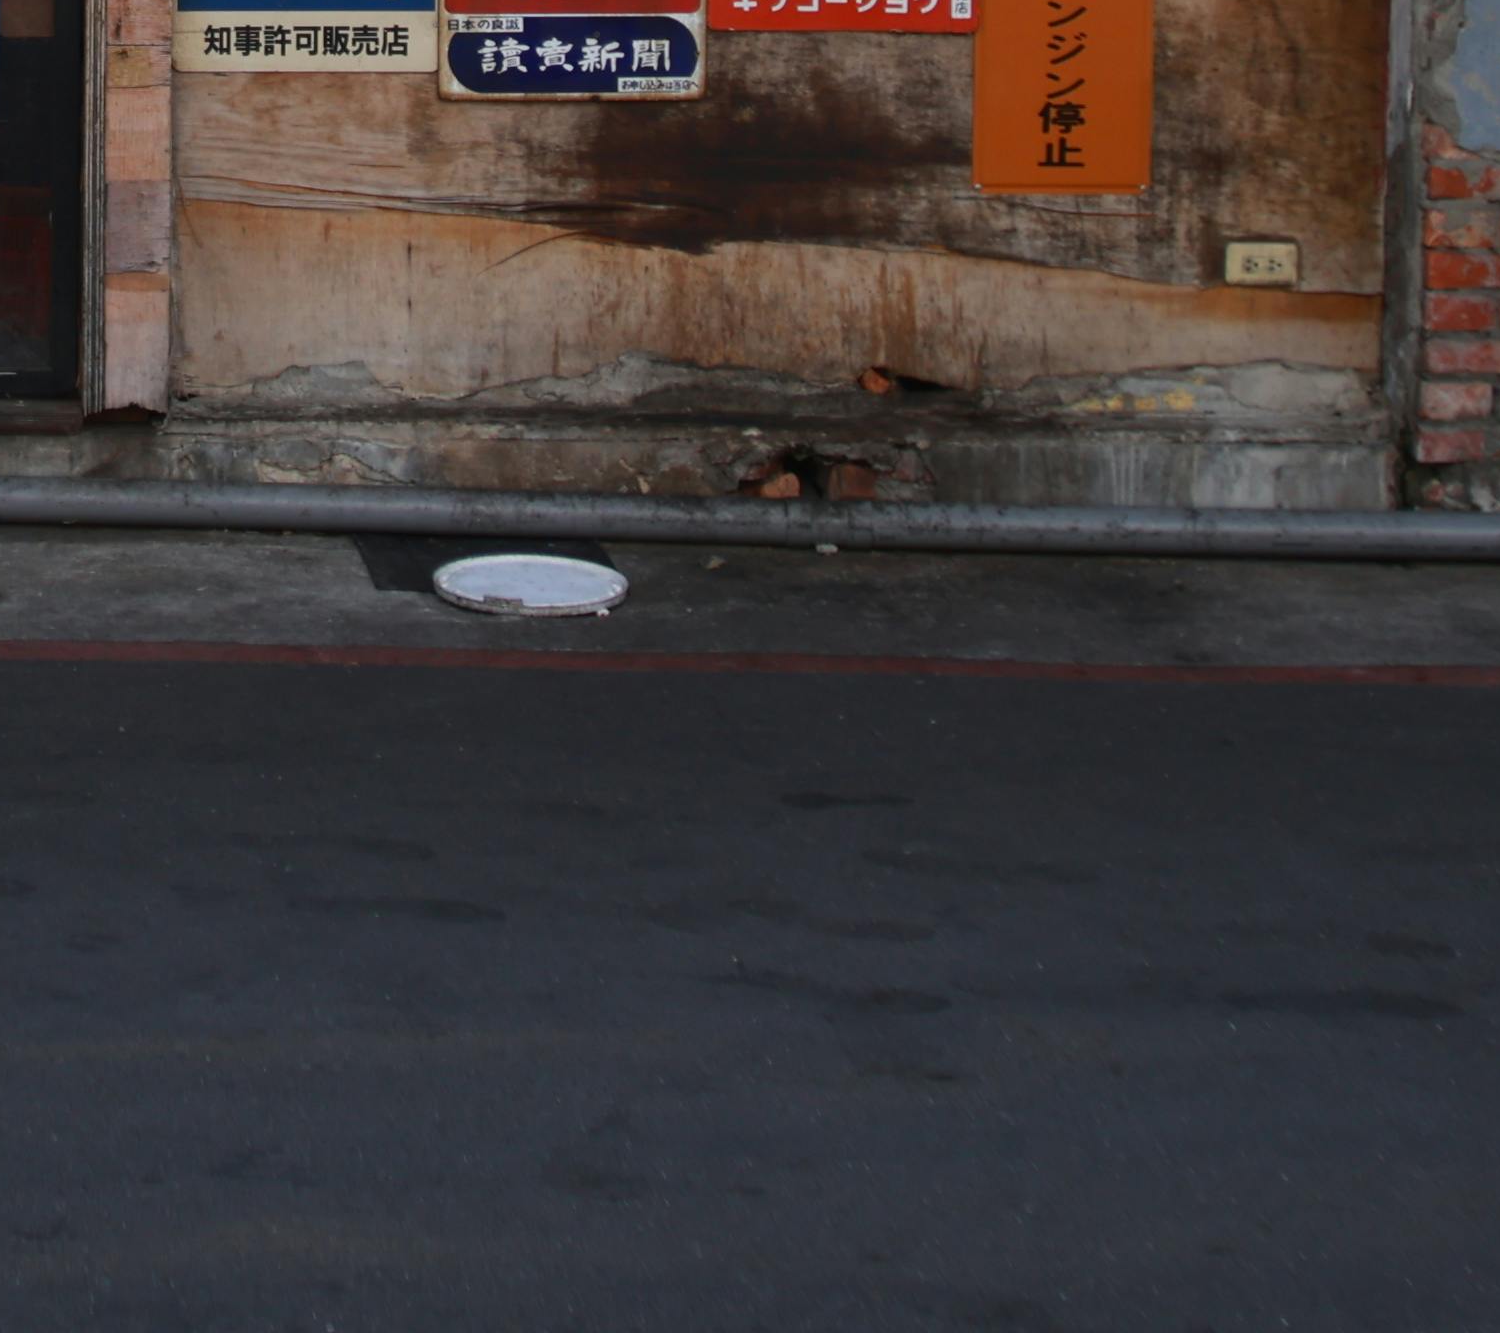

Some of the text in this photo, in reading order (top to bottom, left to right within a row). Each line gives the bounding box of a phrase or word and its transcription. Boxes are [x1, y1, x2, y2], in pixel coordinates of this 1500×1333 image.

[203, 24, 410, 57] 知事許可販売店
[447, 18, 521, 31] 日本の良識
[477, 36, 671, 74] 讀賣新聞
